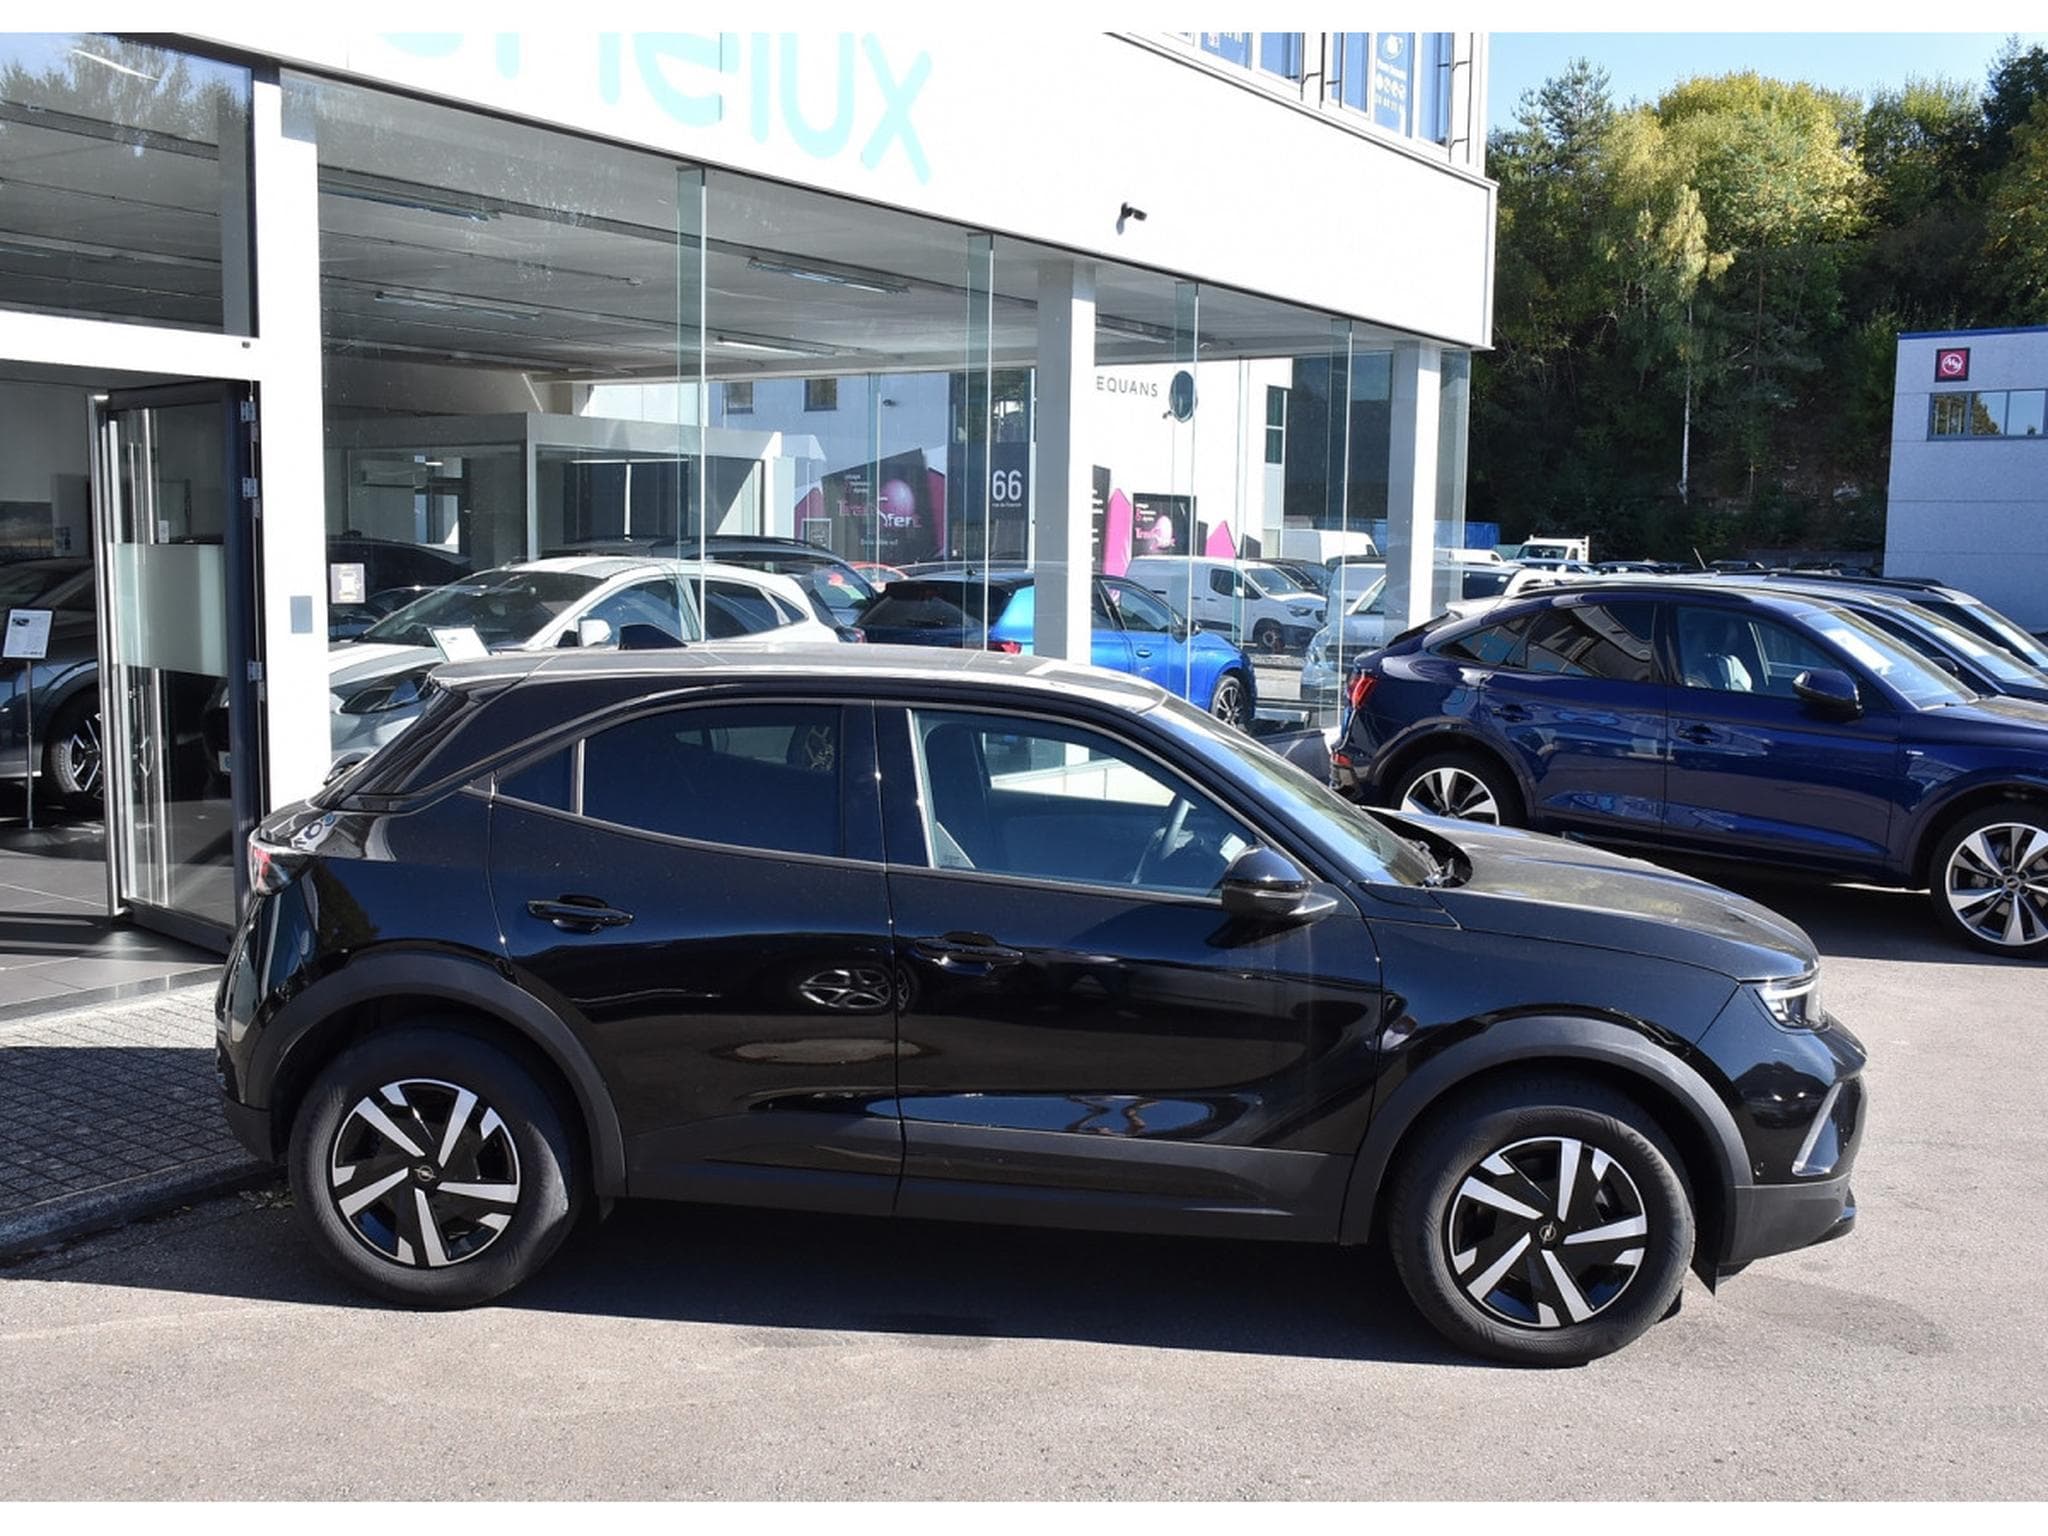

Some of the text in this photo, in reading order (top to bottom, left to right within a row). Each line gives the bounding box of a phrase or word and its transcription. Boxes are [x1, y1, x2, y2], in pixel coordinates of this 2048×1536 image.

[378, 32, 933, 186] elux
[1096, 375, 1159, 397] EQUANS
[992, 470, 1022, 501] 66
